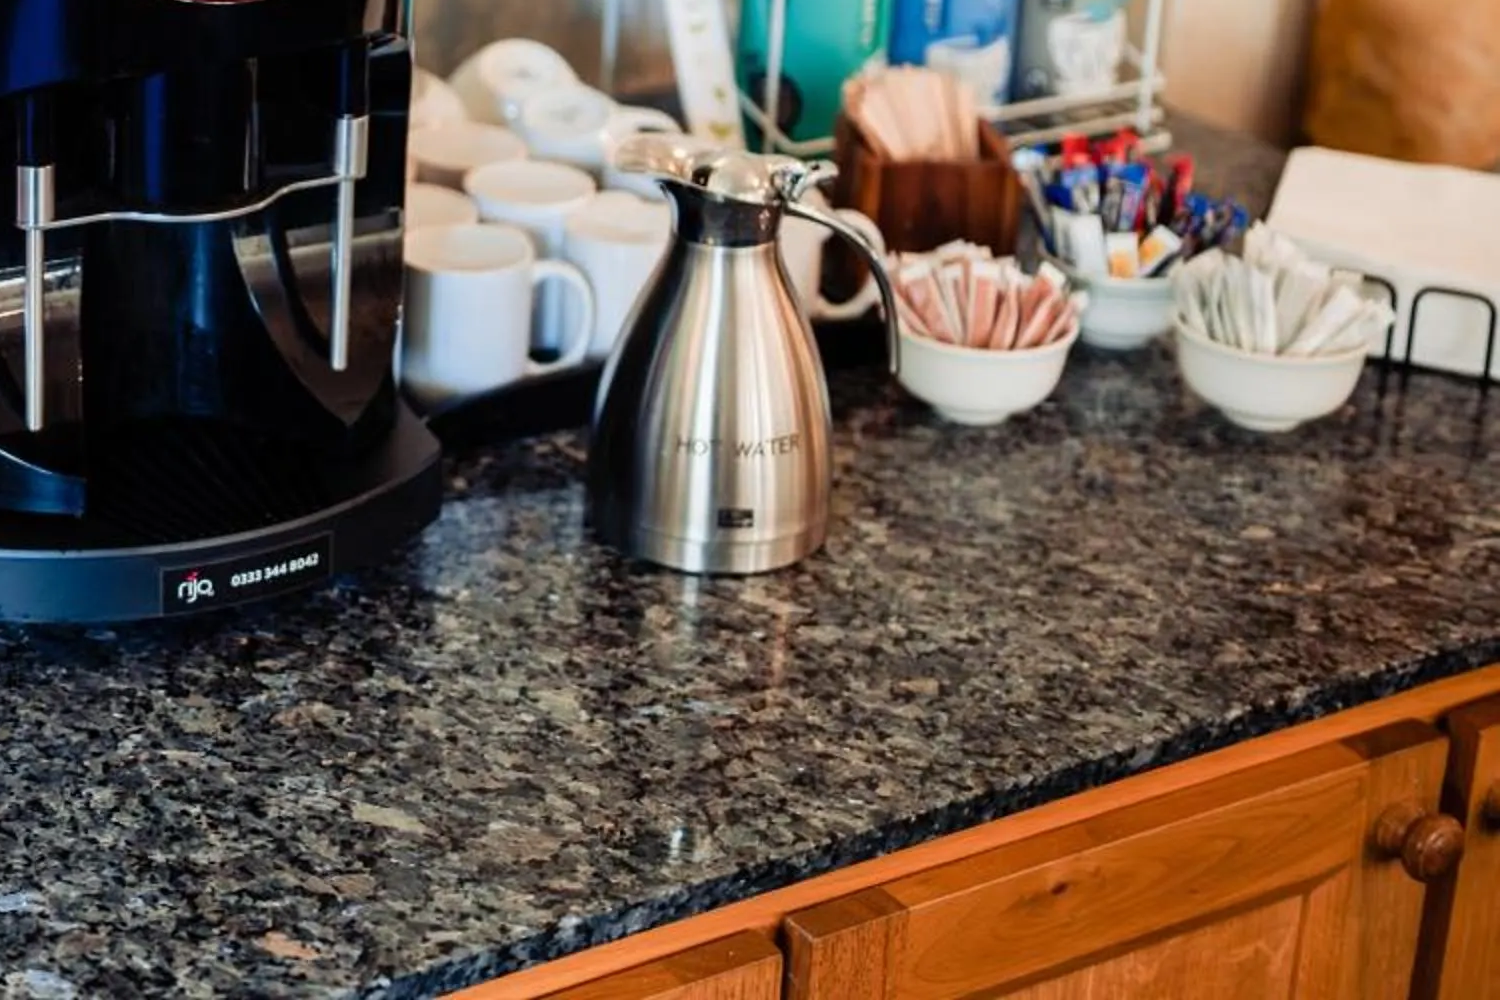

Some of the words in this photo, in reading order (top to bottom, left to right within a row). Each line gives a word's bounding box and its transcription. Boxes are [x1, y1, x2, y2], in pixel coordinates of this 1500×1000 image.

[675, 434, 721, 457] HOT
[733, 433, 802, 457] WATER
[177, 568, 214, 604] rijo
[230, 569, 262, 587] 0333
[264, 564, 288, 580] 344
[289, 552, 320, 573] 8042
